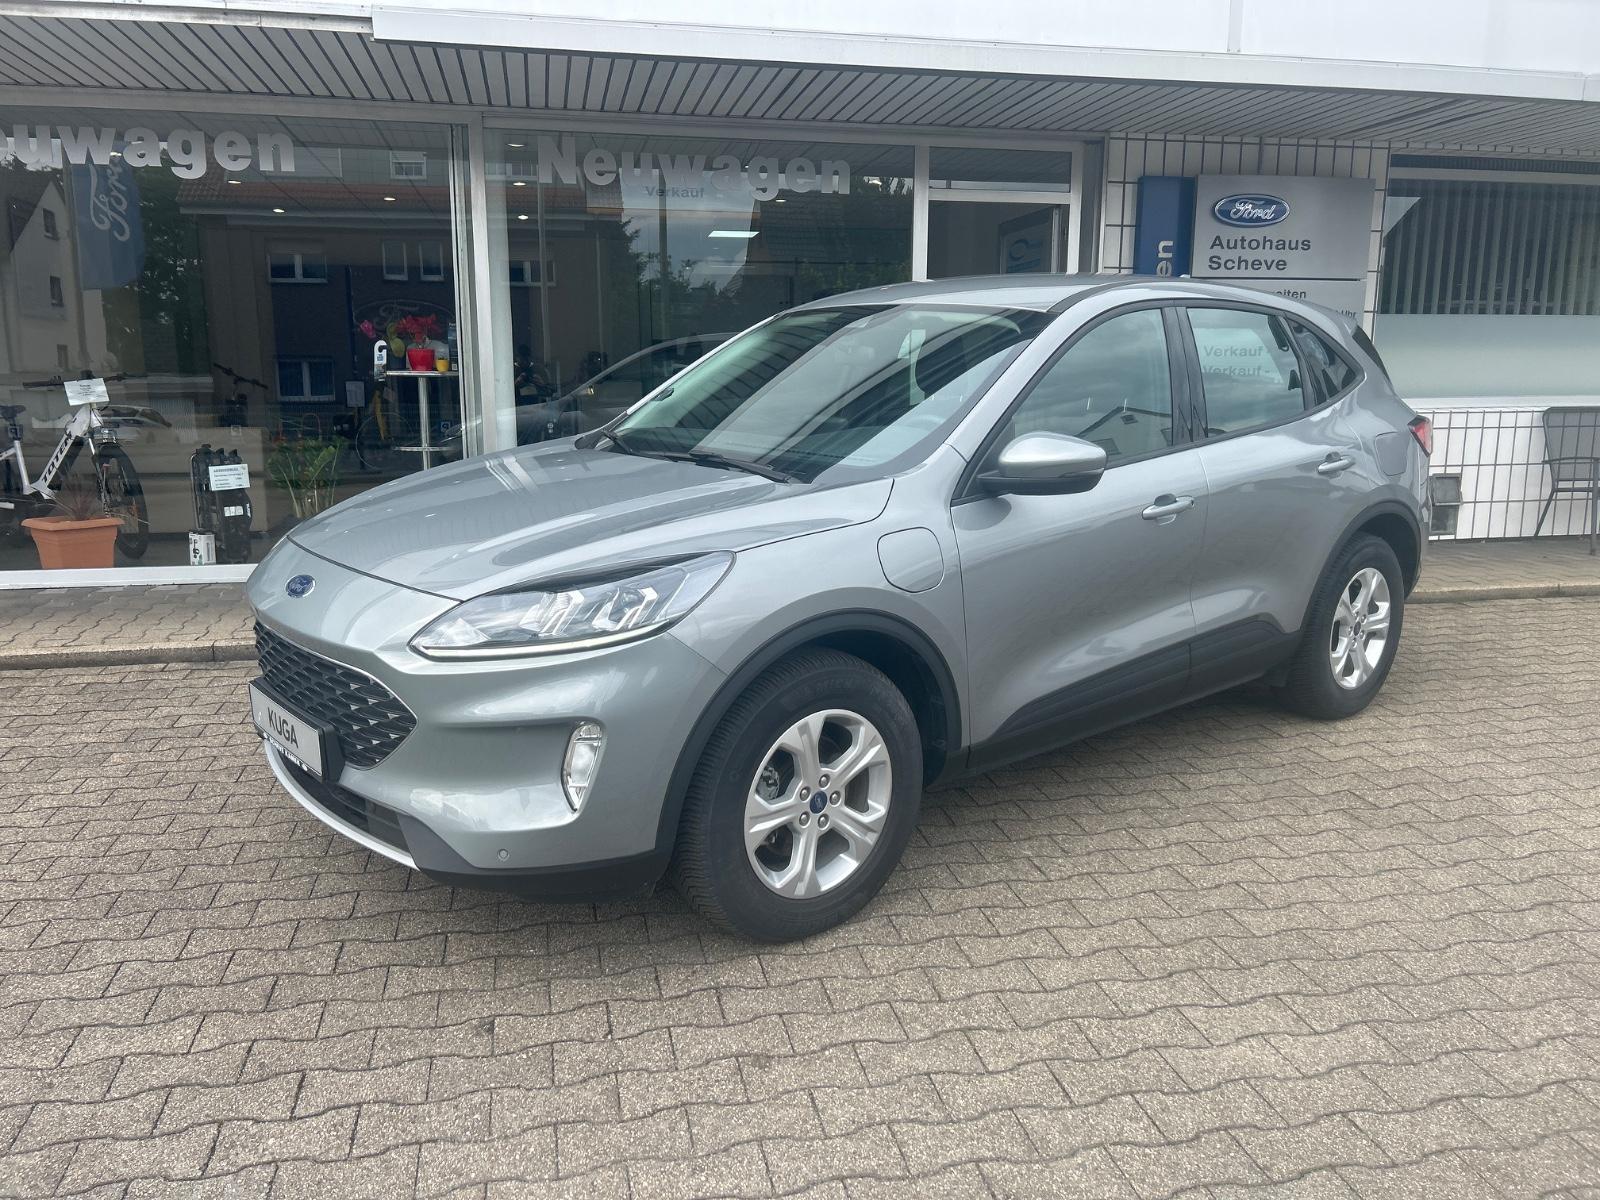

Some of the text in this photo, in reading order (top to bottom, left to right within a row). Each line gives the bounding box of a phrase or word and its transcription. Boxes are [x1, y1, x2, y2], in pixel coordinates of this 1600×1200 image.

[0, 122, 295, 180] uwagen
[537, 135, 851, 201] Neuwagen
[645, 185, 705, 199] Verkauf
[1230, 199, 1277, 219] Ford
[1209, 235, 1312, 251] Autohaus
[1207, 255, 1288, 270] Scheve
[1203, 345, 1264, 357] Verkauf
[1202, 365, 1262, 377] Verkauf
[267, 706, 299, 749] KUGA
